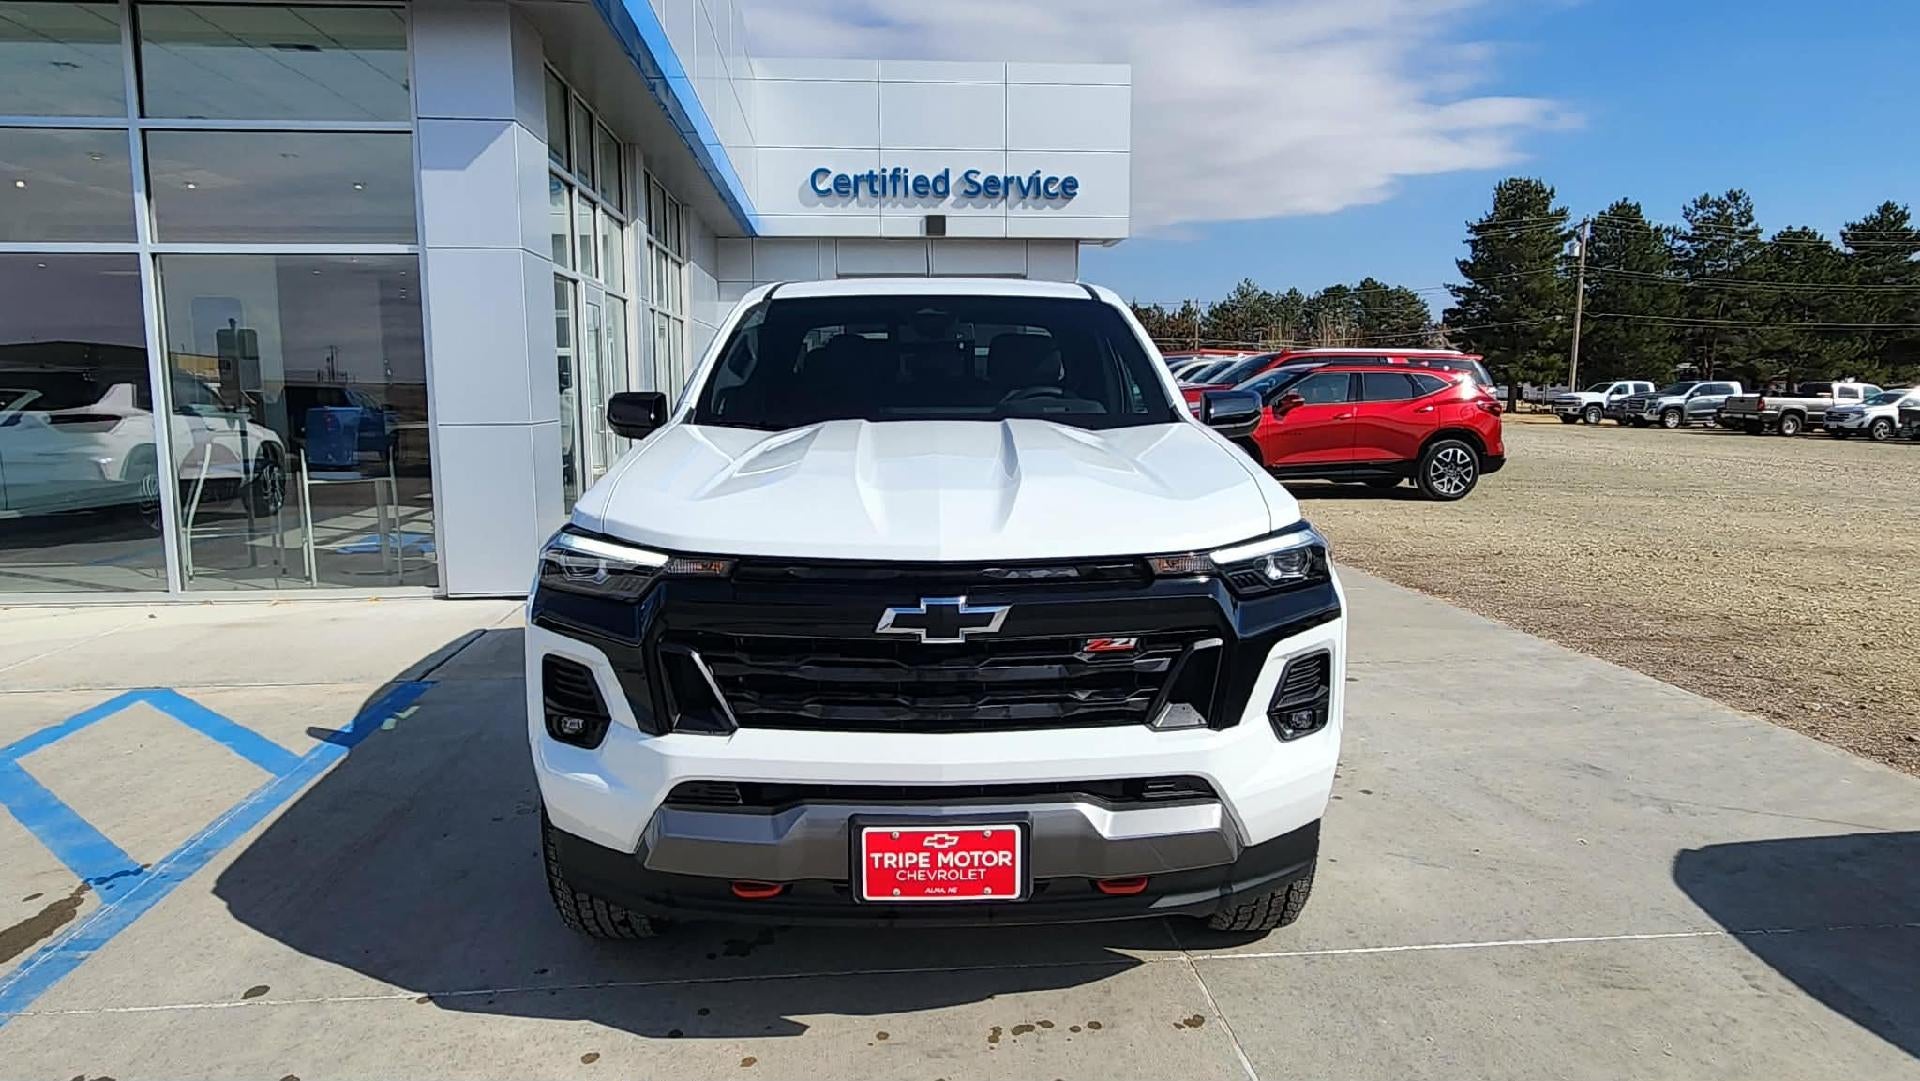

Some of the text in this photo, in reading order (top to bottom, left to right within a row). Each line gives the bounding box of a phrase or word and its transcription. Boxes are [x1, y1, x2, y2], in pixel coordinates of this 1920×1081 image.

[810, 167, 1079, 200] Certified Service
[870, 851, 1013, 868] TRIPE MOTOR
[895, 869, 987, 882] CHEVROLET
